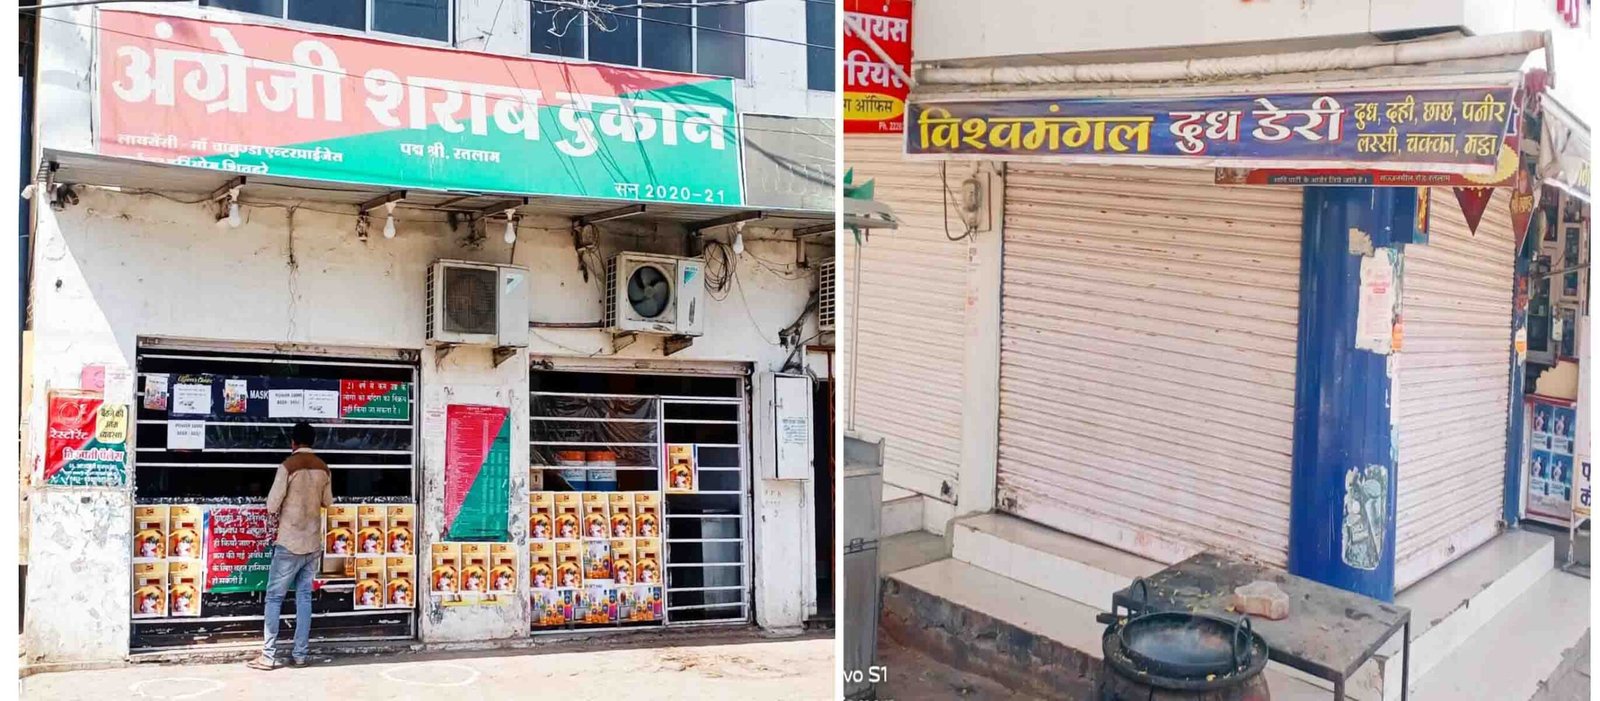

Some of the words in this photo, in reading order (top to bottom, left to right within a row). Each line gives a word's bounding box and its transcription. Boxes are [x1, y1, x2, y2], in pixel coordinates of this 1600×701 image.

[112, 22, 346, 122] अंग्रेजी
[364, 67, 542, 139] शराब
[555, 89, 728, 157] दुकान
[855, 95, 894, 113] ऑफिस
[917, 105, 1154, 153] विश्वमंगल
[1168, 110, 1241, 154] दुध
[1251, 95, 1345, 142] डेरी
[1386, 95, 1417, 126] दही,
[1423, 101, 1457, 126] छाछ,
[1462, 93, 1507, 122] पनीर
[452, 147, 500, 163] रतलाम
[1357, 126, 1401, 155] लस्सी,
[1406, 133, 1459, 157] चक्का,
[645, 184, 725, 203] 2020-21
